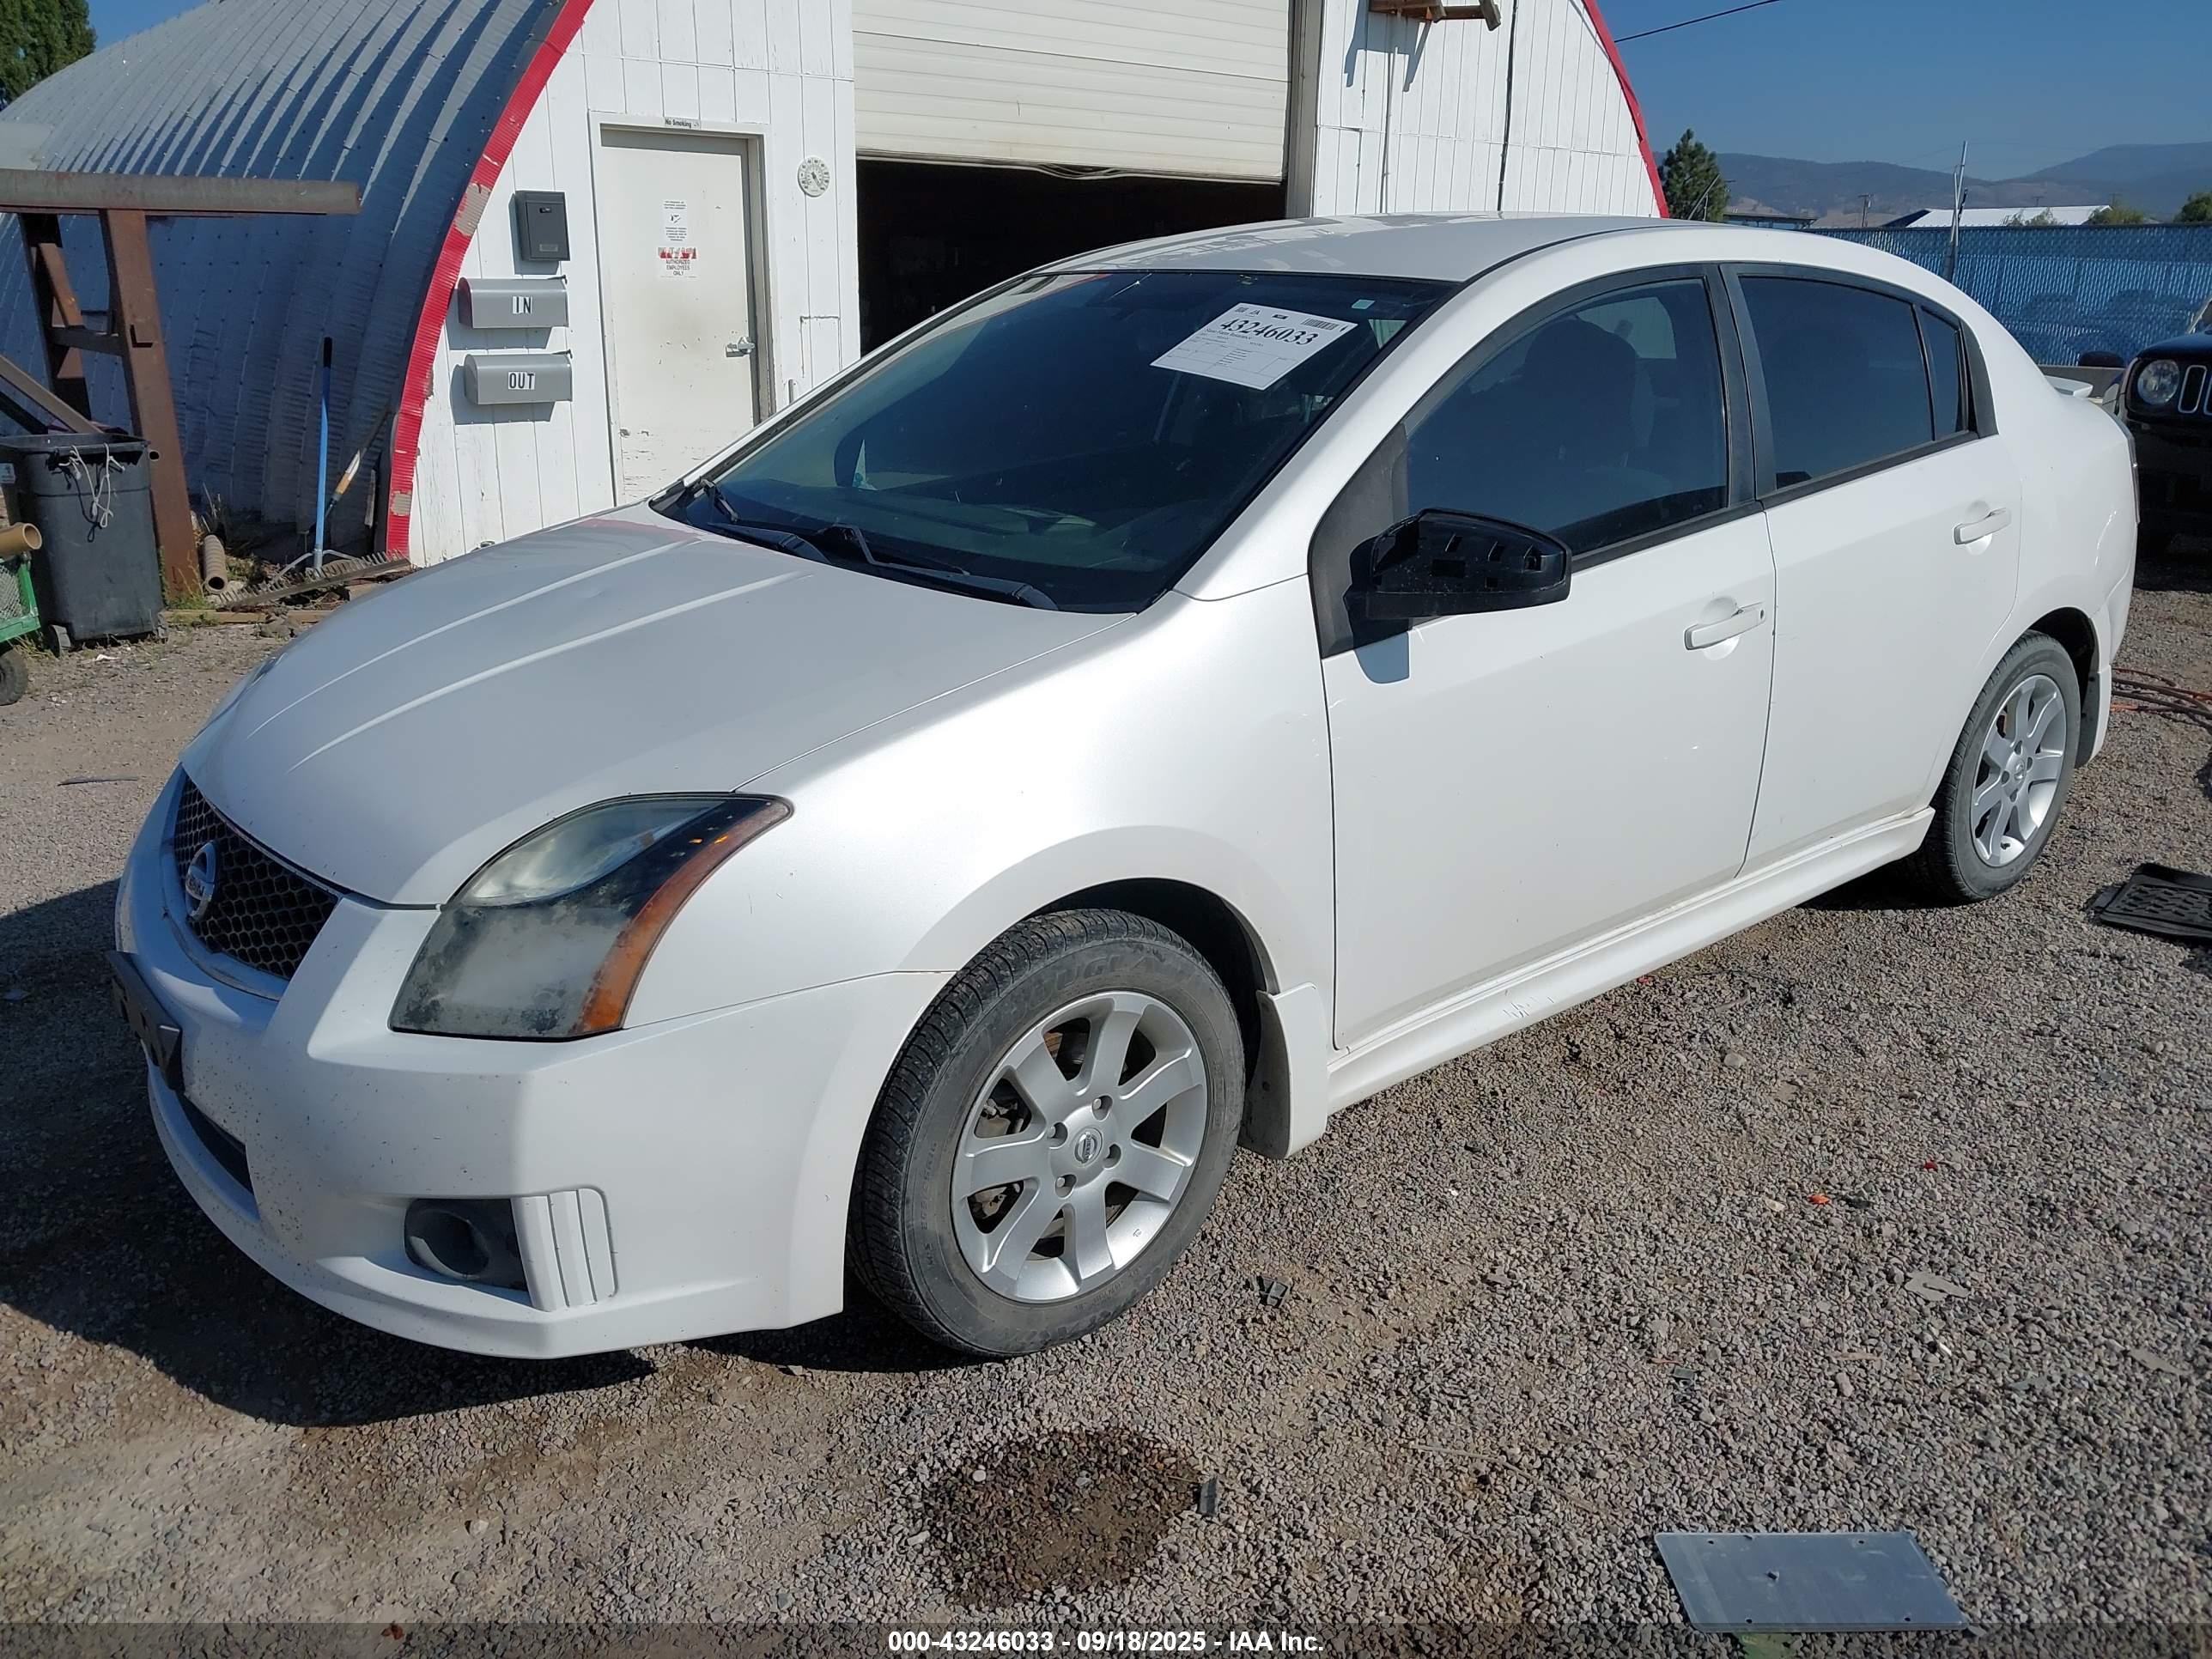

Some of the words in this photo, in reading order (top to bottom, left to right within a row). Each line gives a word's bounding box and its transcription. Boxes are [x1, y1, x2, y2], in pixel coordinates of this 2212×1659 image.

[672, 118, 691, 128] Smoking
[516, 296, 532, 313] IN
[1220, 318, 1319, 345] 43246033
[509, 373, 534, 389] OUT
